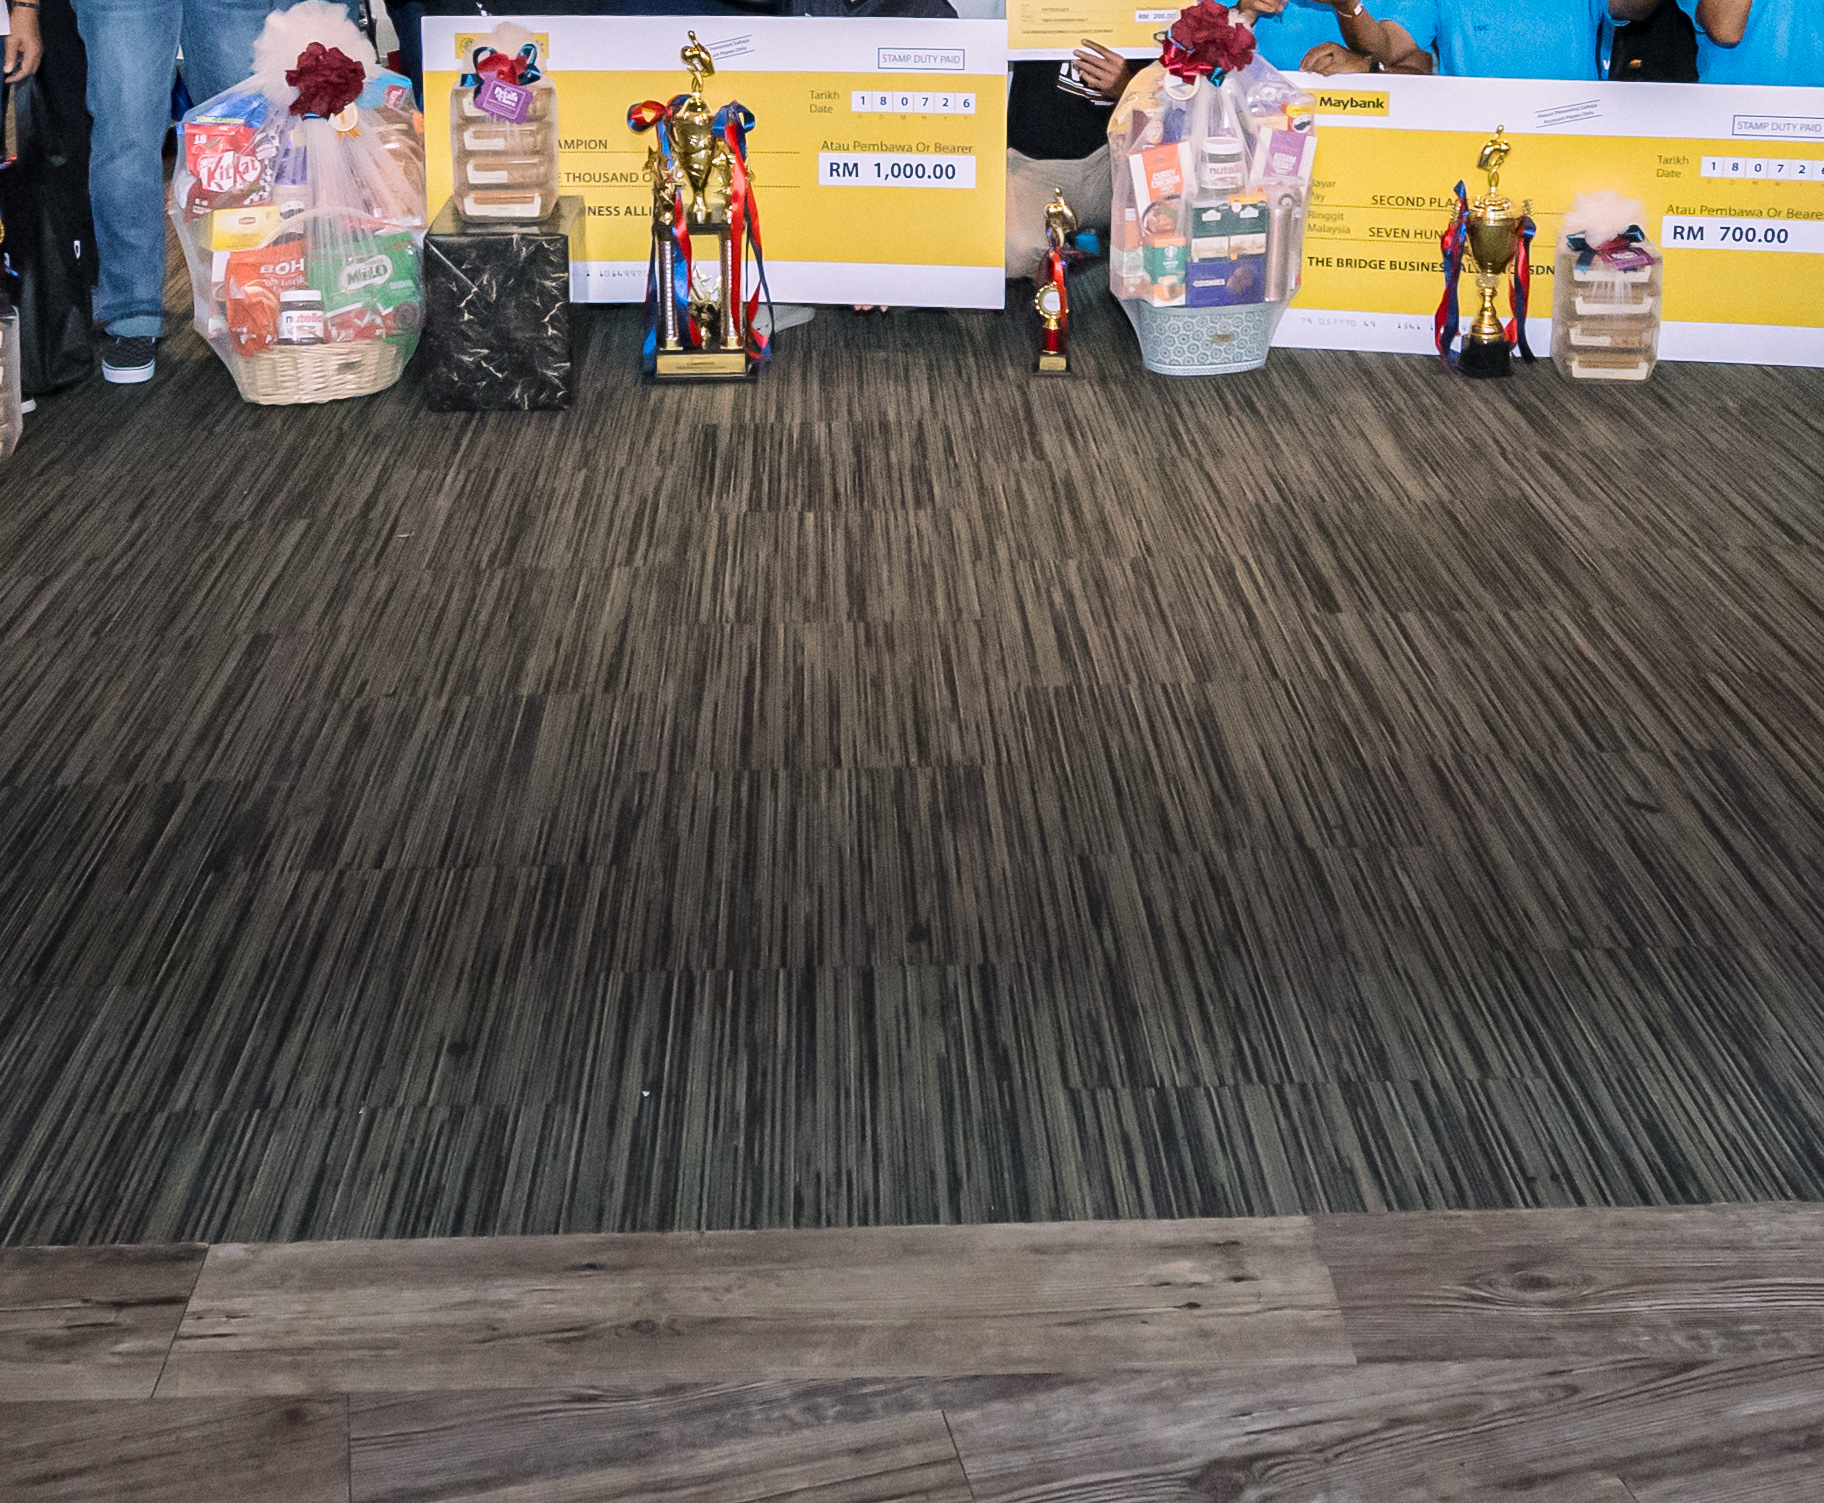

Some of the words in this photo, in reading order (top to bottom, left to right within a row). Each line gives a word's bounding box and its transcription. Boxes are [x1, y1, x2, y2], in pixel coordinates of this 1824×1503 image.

[883, 54, 911, 63] STAMP
[914, 55, 937, 63] DUTY
[941, 55, 960, 64] PAID
[809, 91, 839, 100] Tarikh
[809, 104, 833, 113] Date
[1319, 96, 1385, 111] Maybank
[1737, 121, 1769, 131] STAMP
[1771, 123, 1798, 132] DUTY
[1800, 124, 1822, 133] PAID
[558, 139, 608, 150] AMPION
[821, 141, 850, 151] Atau
[854, 141, 913, 152] Pembawa
[916, 142, 930, 152] Or
[934, 143, 974, 153] Bearer
[1657, 155, 1690, 165] Tarikh
[199, 152, 261, 191] KitKat
[566, 172, 635, 183] THOUSAND
[829, 162, 859, 177] RM
[874, 163, 956, 181] 1,000.00
[1656, 169, 1682, 178] Date
[1372, 195, 1426, 208] SECOND
[584, 206, 620, 217] INESS
[623, 206, 652, 217] ALLI
[1666, 204, 1696, 215] Atau
[1700, 205, 1763, 217] Pembawa
[1767, 207, 1782, 218] Or
[1307, 223, 1351, 234] Malaysia
[1368, 227, 1410, 239] SEVEN
[1672, 225, 1704, 240] RM
[1720, 226, 1789, 244] 700.00
[260, 259, 304, 274] BOH
[1308, 256, 1333, 267] THE
[1336, 258, 1386, 270] BRIDGE
[1390, 260, 1446, 272] BUSINES
[285, 314, 322, 325] ntella
